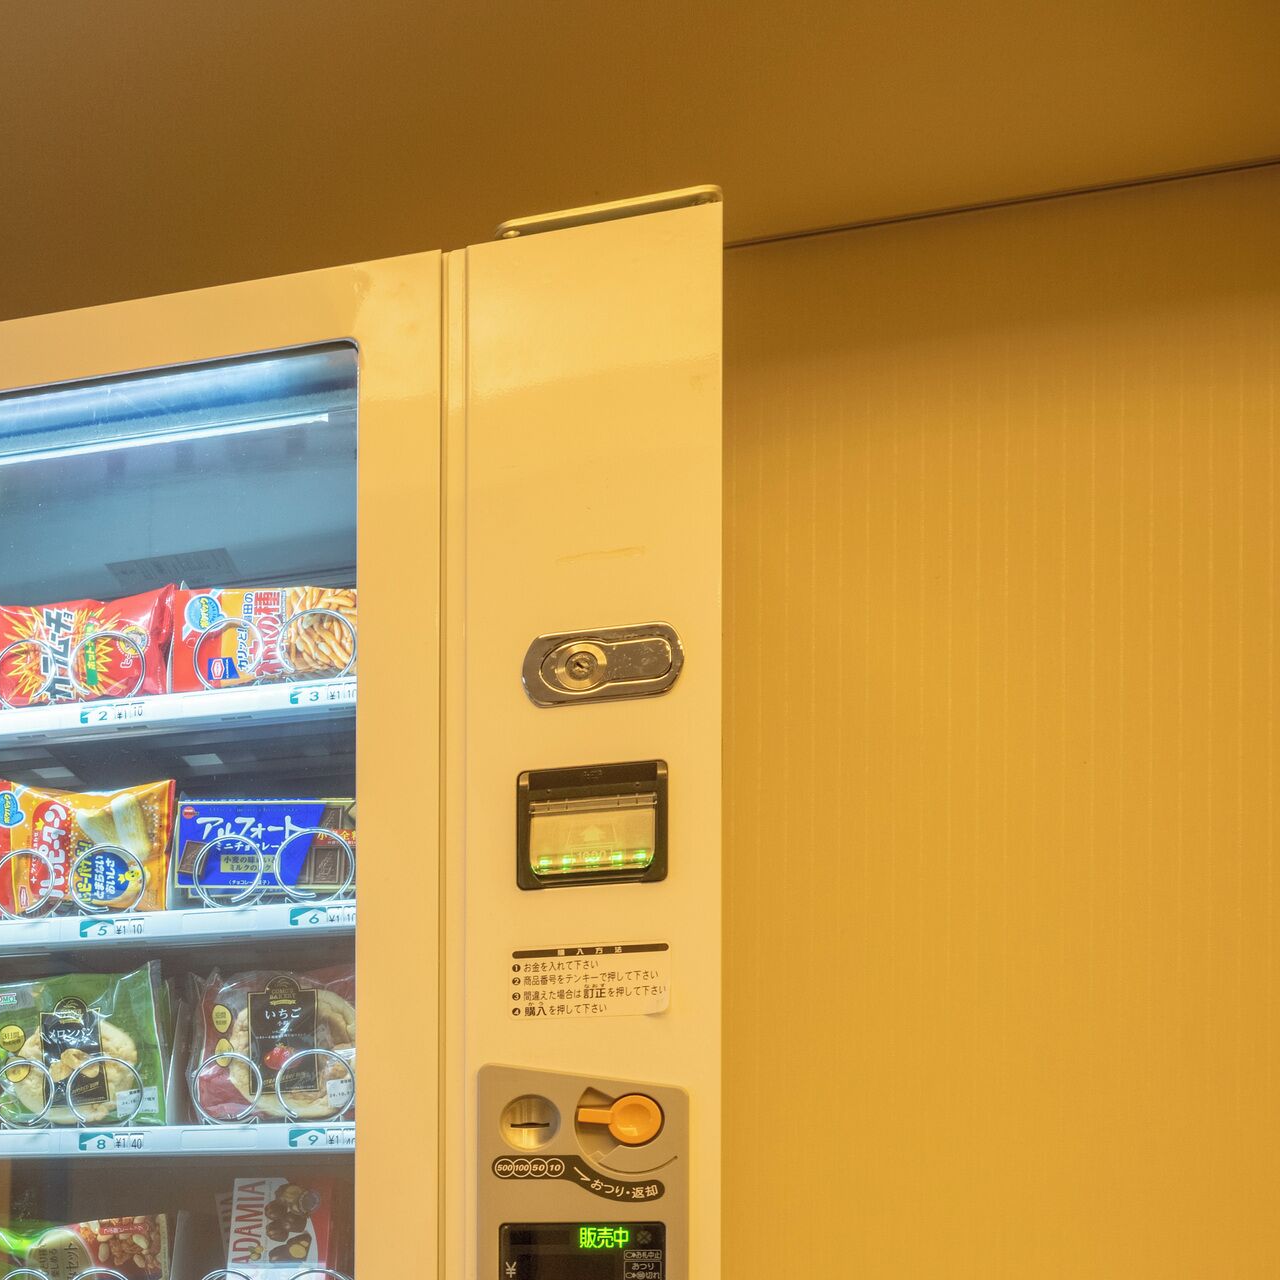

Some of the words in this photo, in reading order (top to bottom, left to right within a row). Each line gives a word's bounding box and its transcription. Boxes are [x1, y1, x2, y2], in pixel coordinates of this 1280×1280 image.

[309, 691, 319, 701] 3
[98, 710, 108, 721] 2
[196, 815, 307, 840] アルフォート
[94, 855, 104, 899] とまらない
[308, 913, 320, 925] 6
[97, 925, 108, 936] 5
[523, 960, 599, 974] お金を入れて下さい
[523, 971, 659, 986] 商品番号をテンキーで押して下さい
[264, 1006, 302, 1020] いちご
[96, 1139, 106, 1150] 8
[308, 1135, 319, 1145] 9
[497, 1163, 512, 1171] 500
[515, 1163, 529, 1171] 100
[532, 1163, 545, 1171] 50
[549, 1163, 561, 1171] 10
[591, 1178, 658, 1199] おつり・返却
[579, 1226, 630, 1249] 販売中
[506, 1261, 517, 1278] ¥
[631, 1262, 655, 1270] おつり
